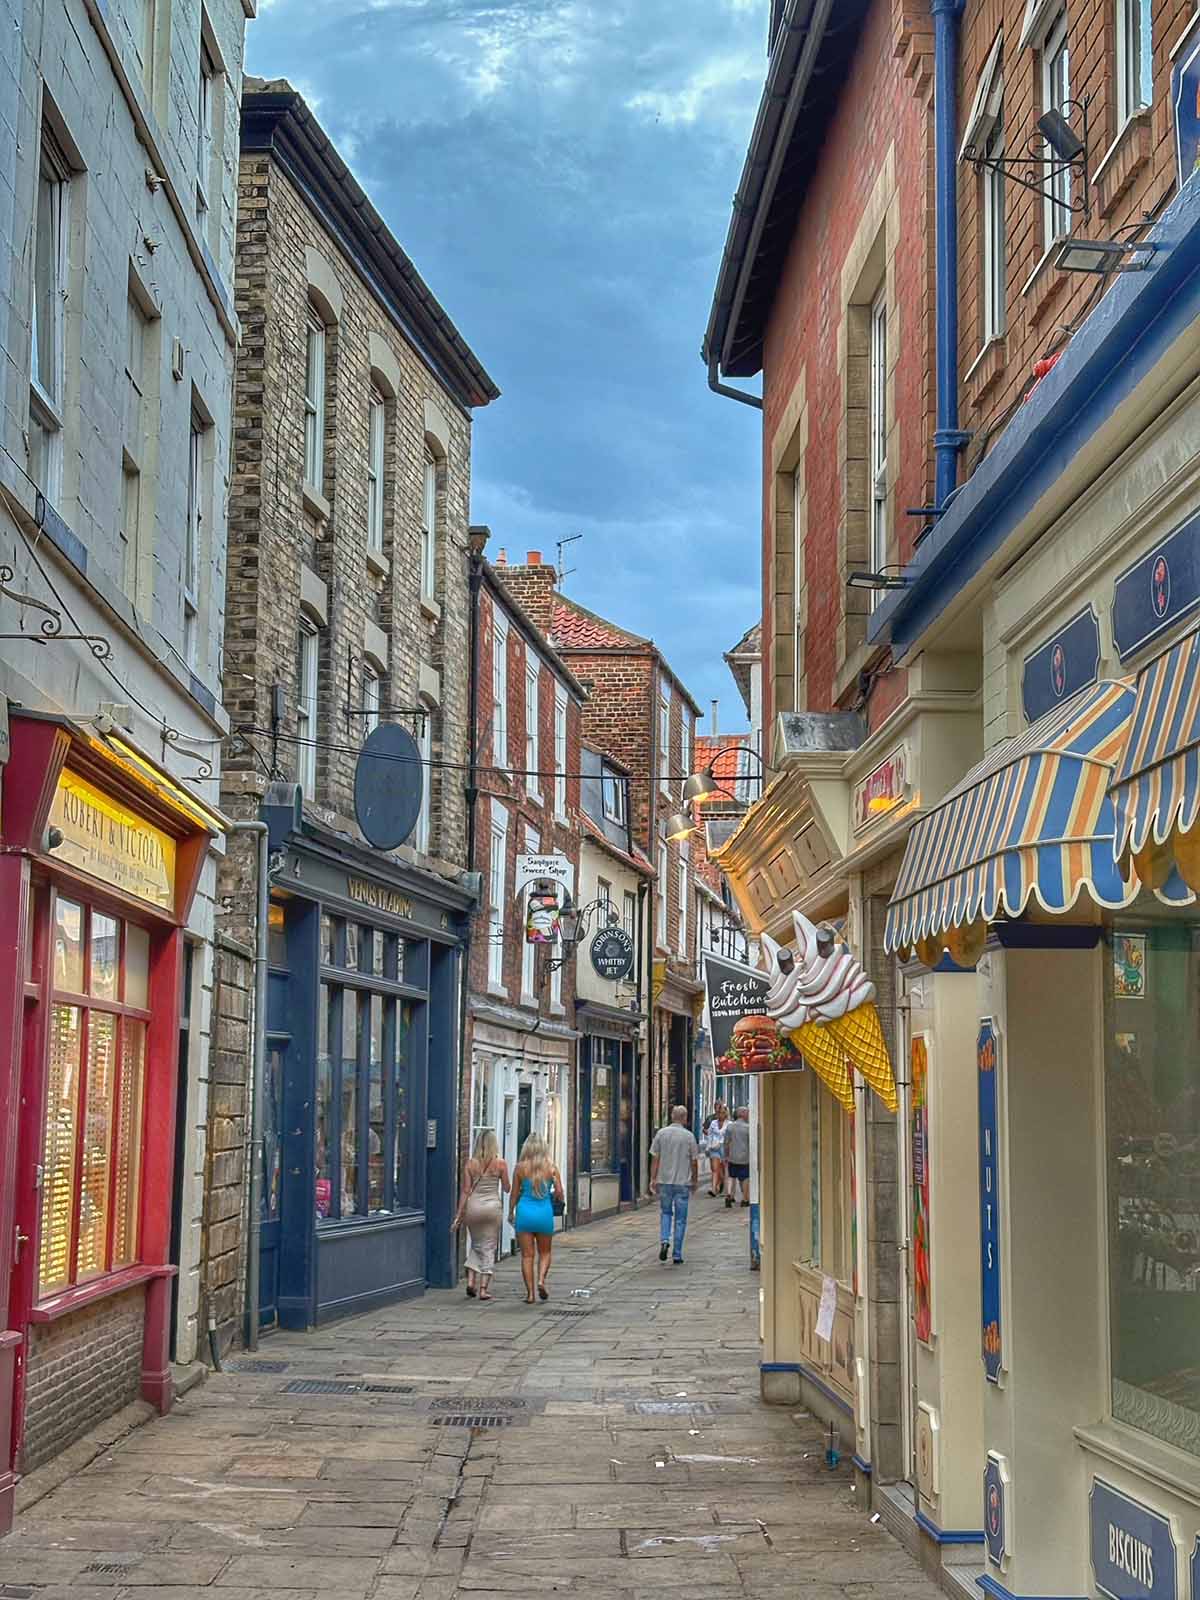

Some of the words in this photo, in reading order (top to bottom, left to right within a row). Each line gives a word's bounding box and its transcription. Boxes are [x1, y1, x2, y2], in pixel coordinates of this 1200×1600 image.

[108, 818, 115, 847] &
[347, 877, 377, 906] VENUS
[597, 957, 627, 966] WHITBY
[606, 966, 617, 976] JET
[720, 977, 759, 993] Fresh
[984, 1128, 993, 1270] NUTS
[1109, 1522, 1153, 1589] BISCUITS
